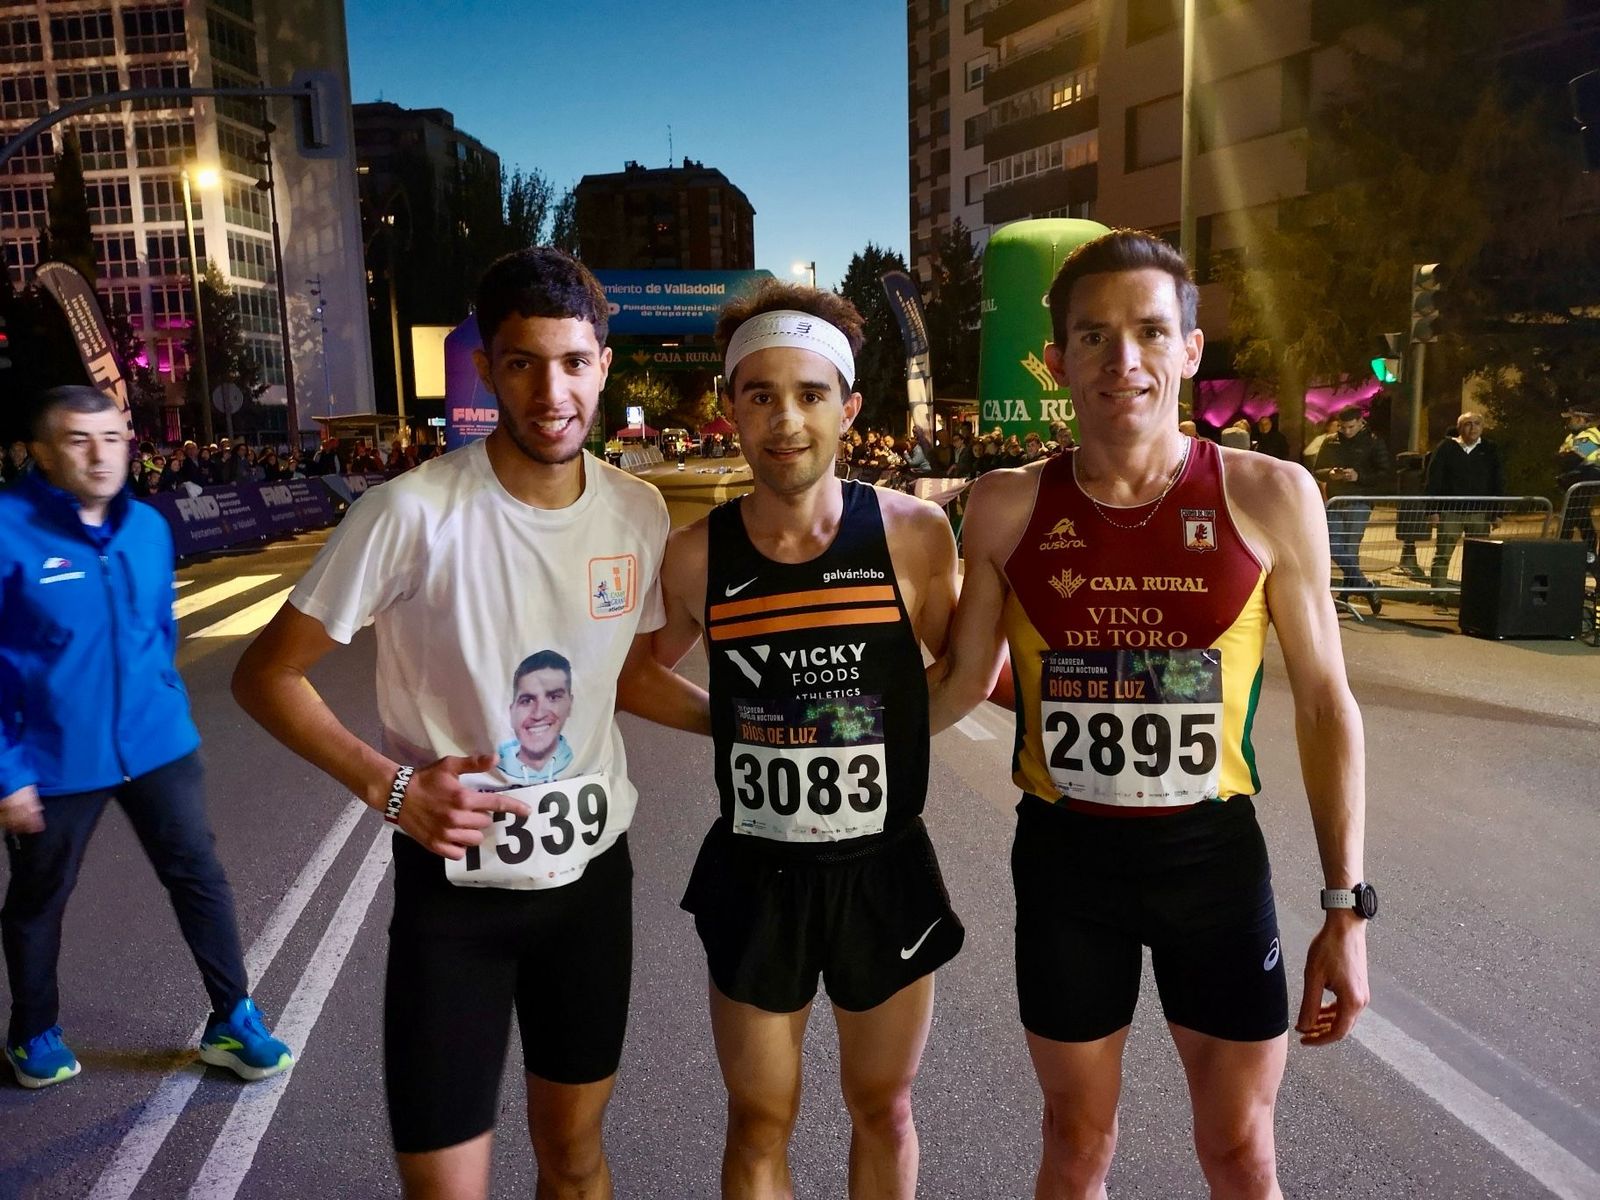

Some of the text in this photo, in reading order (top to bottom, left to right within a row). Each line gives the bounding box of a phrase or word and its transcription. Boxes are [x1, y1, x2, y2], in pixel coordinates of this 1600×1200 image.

[602, 283, 726, 294] miento de Valladolid
[653, 352, 682, 363] CAJA
[452, 408, 500, 422] FMD
[983, 400, 1077, 422] CAJA RU
[1089, 577, 1208, 593] CAJA RURAL
[1086, 607, 1163, 625] VINO
[1064, 630, 1188, 648] DE TORO
[780, 642, 866, 669] VICKY
[1057, 658, 1085, 666] CARRERA
[792, 667, 860, 687] FOODS
[1076, 666, 1108, 675] NOCTURNA
[795, 687, 861, 700] ATHLETICS
[1049, 676, 1146, 699] RÍOS DE LUZ
[742, 722, 818, 745] RÍOS DE LUZ
[1045, 710, 1217, 778] 2895
[734, 753, 883, 816] 3083
